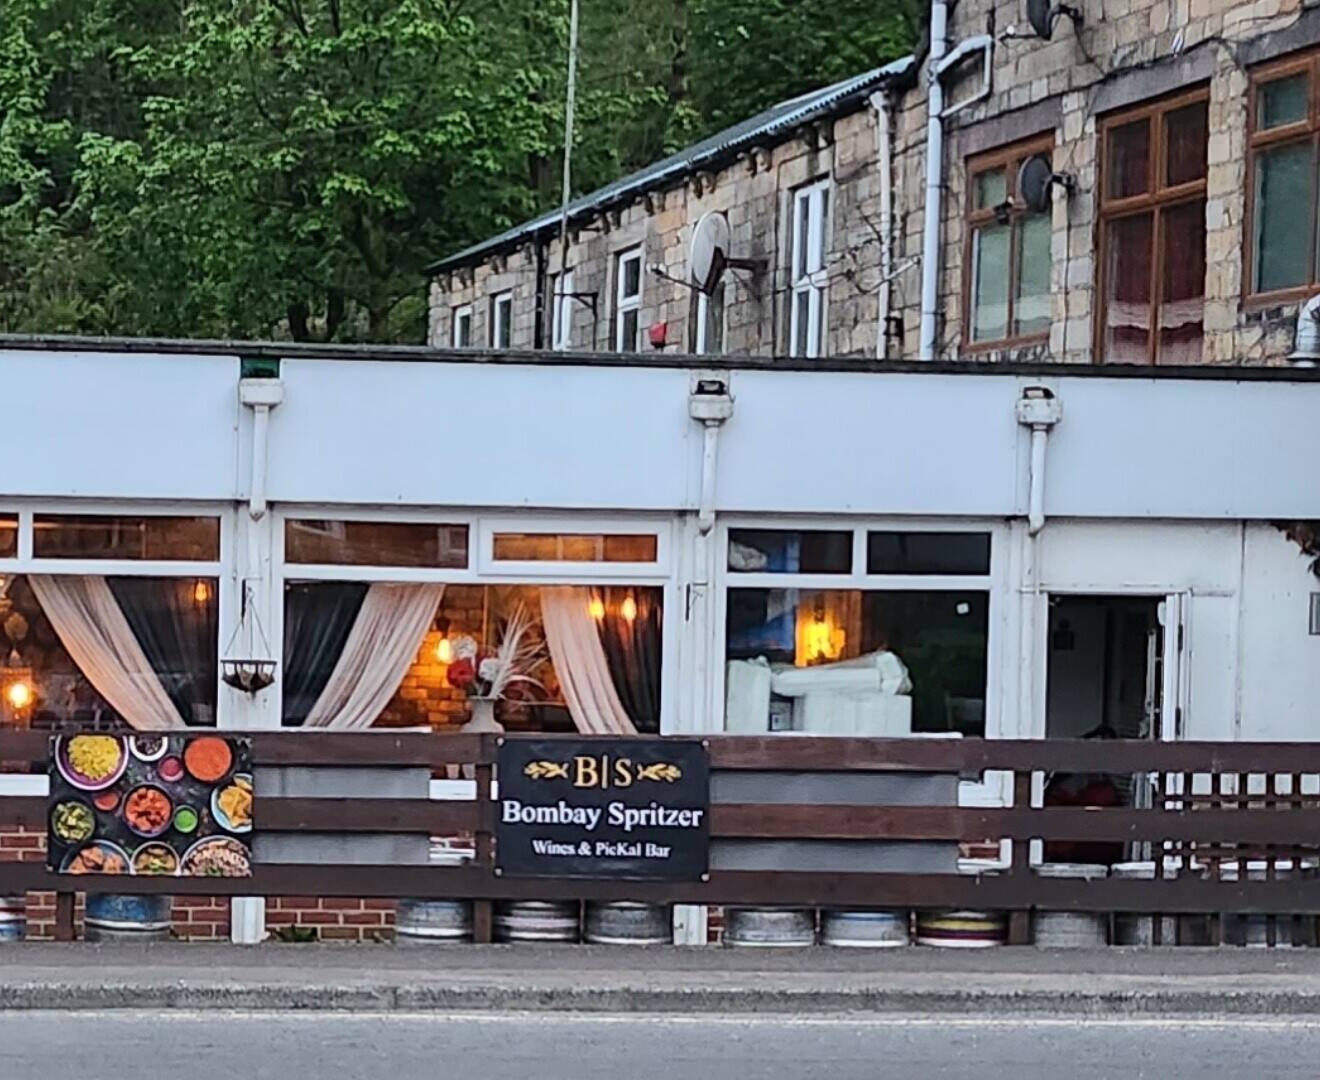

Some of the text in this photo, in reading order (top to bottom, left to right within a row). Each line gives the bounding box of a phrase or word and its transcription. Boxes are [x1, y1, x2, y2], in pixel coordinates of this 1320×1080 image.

[502, 800, 703, 831] Bombay Spritzer
[532, 840, 576, 855] Wines
[578, 842, 592, 855] &
[646, 843, 671, 858] Bar
